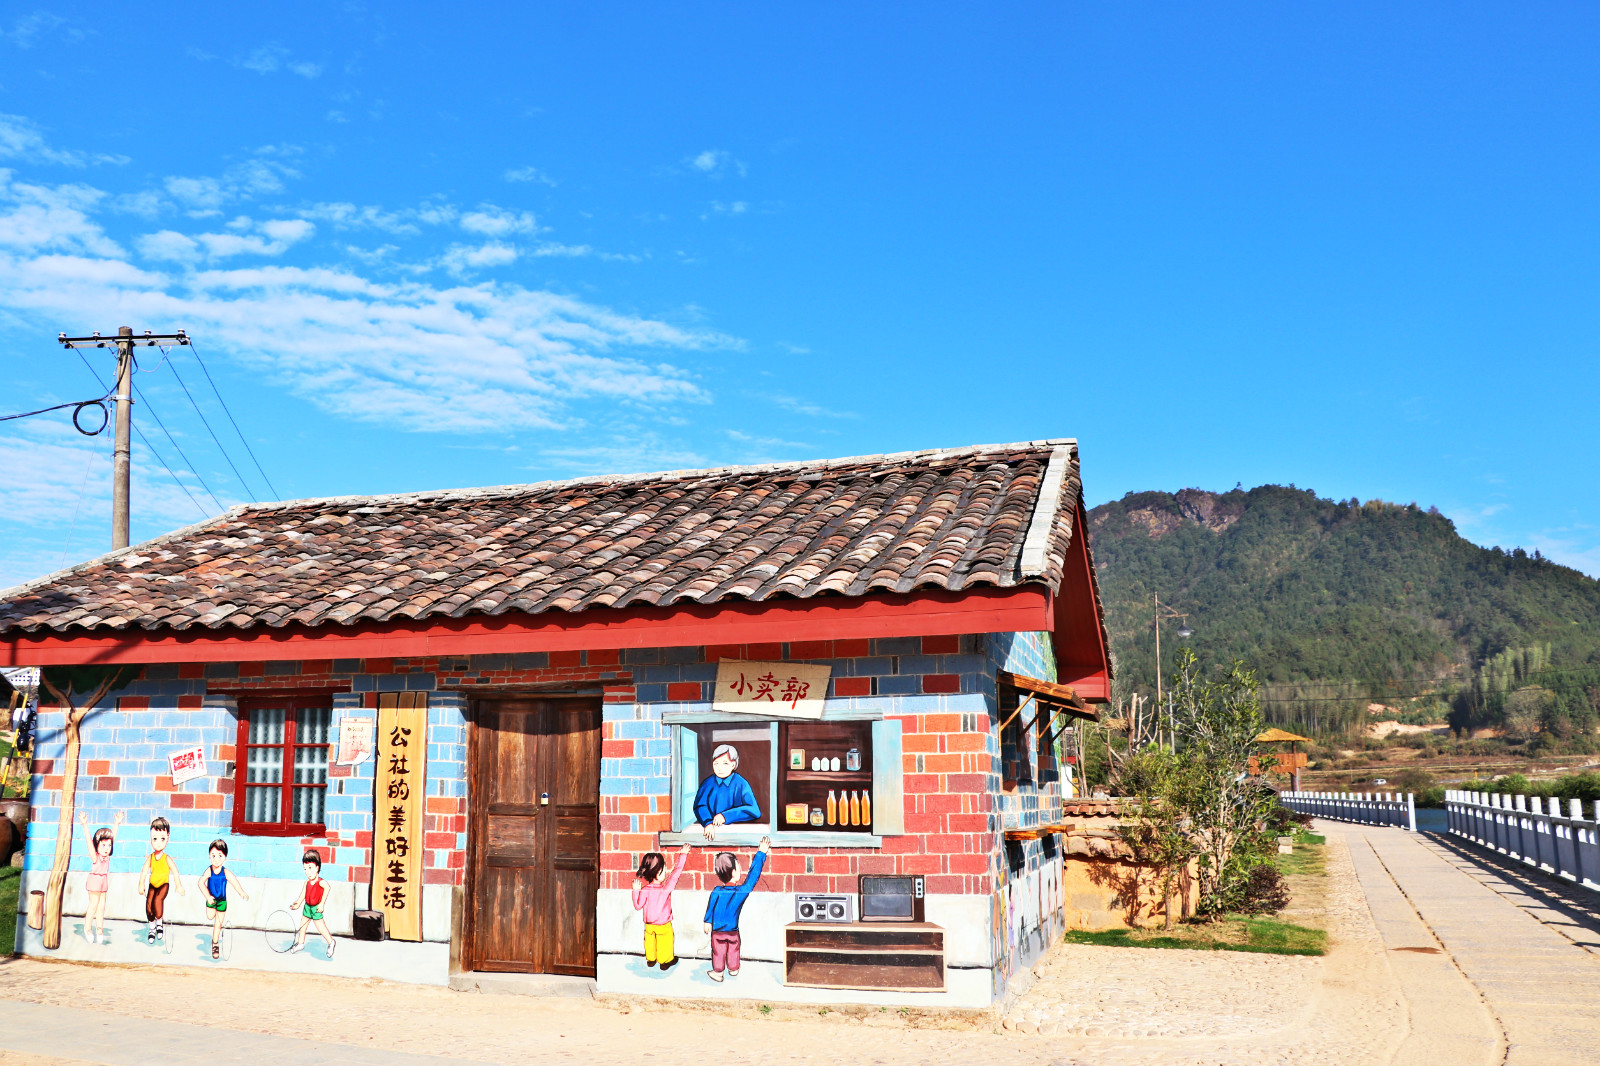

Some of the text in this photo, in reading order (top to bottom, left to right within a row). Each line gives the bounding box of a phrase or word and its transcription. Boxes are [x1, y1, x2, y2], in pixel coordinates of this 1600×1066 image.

[730, 672, 810, 710] 小卖部
[384, 726, 411, 909] 公社的美好生活
